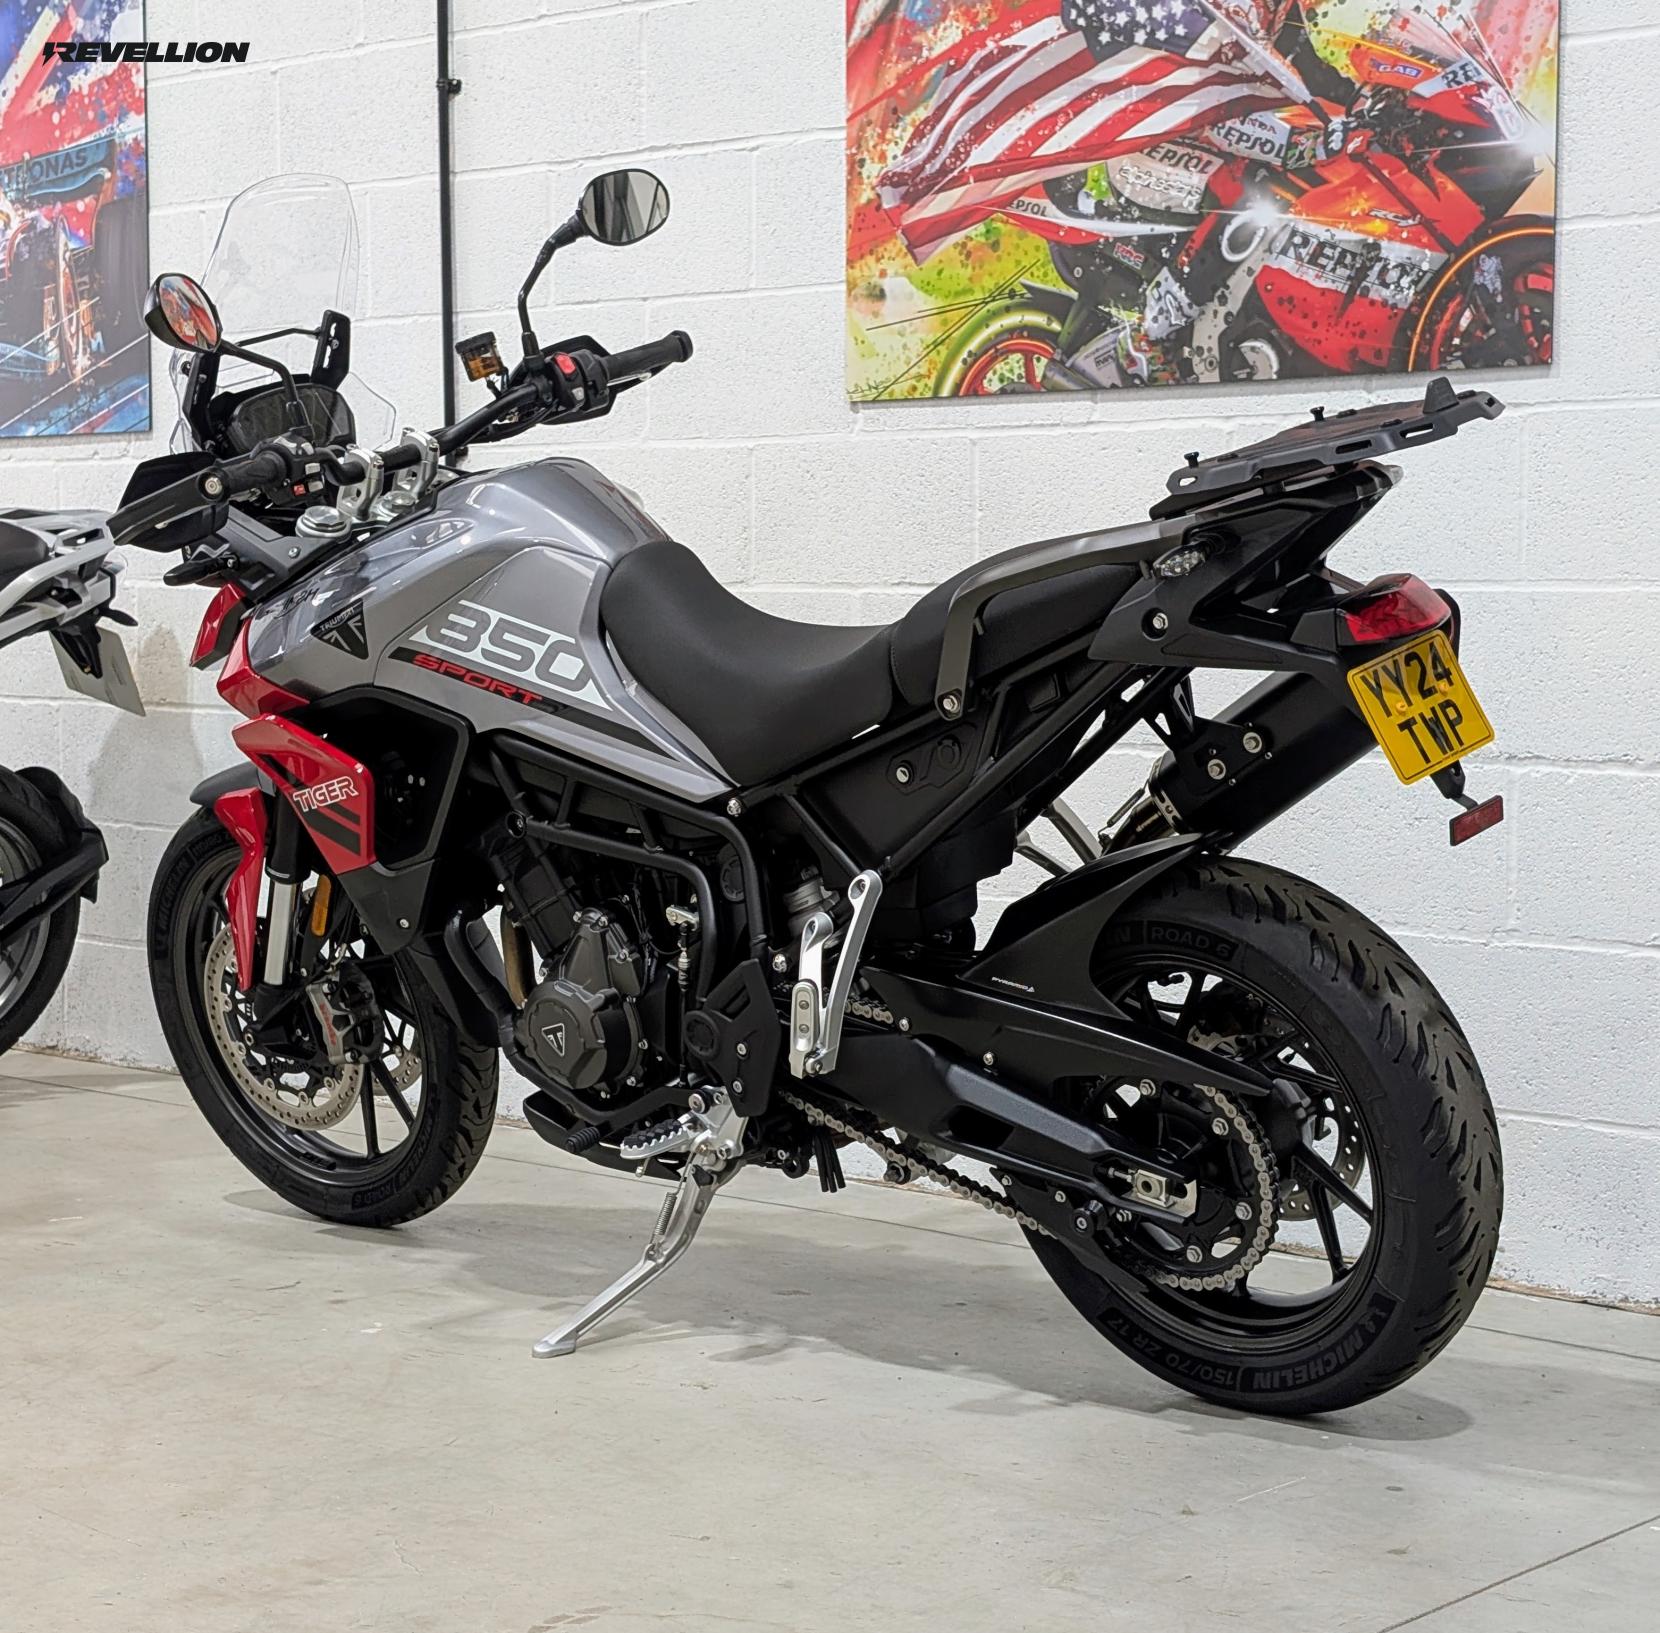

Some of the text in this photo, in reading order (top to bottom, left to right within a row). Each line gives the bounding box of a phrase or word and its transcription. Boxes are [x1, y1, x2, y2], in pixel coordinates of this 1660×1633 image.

[1211, 121, 1285, 159] REPSOL
[1146, 146, 1214, 174] EPSOL
[1008, 199, 1047, 217] EPSOL
[412, 653, 543, 705] SPORT
[1359, 641, 1454, 718] YY24
[1397, 699, 1464, 764] TWP
[293, 776, 359, 812] TIGER
[1152, 926, 1210, 950] ROAD
[1165, 1352, 1235, 1386] 150/70
[1253, 1331, 1365, 1389] MICHELIN
